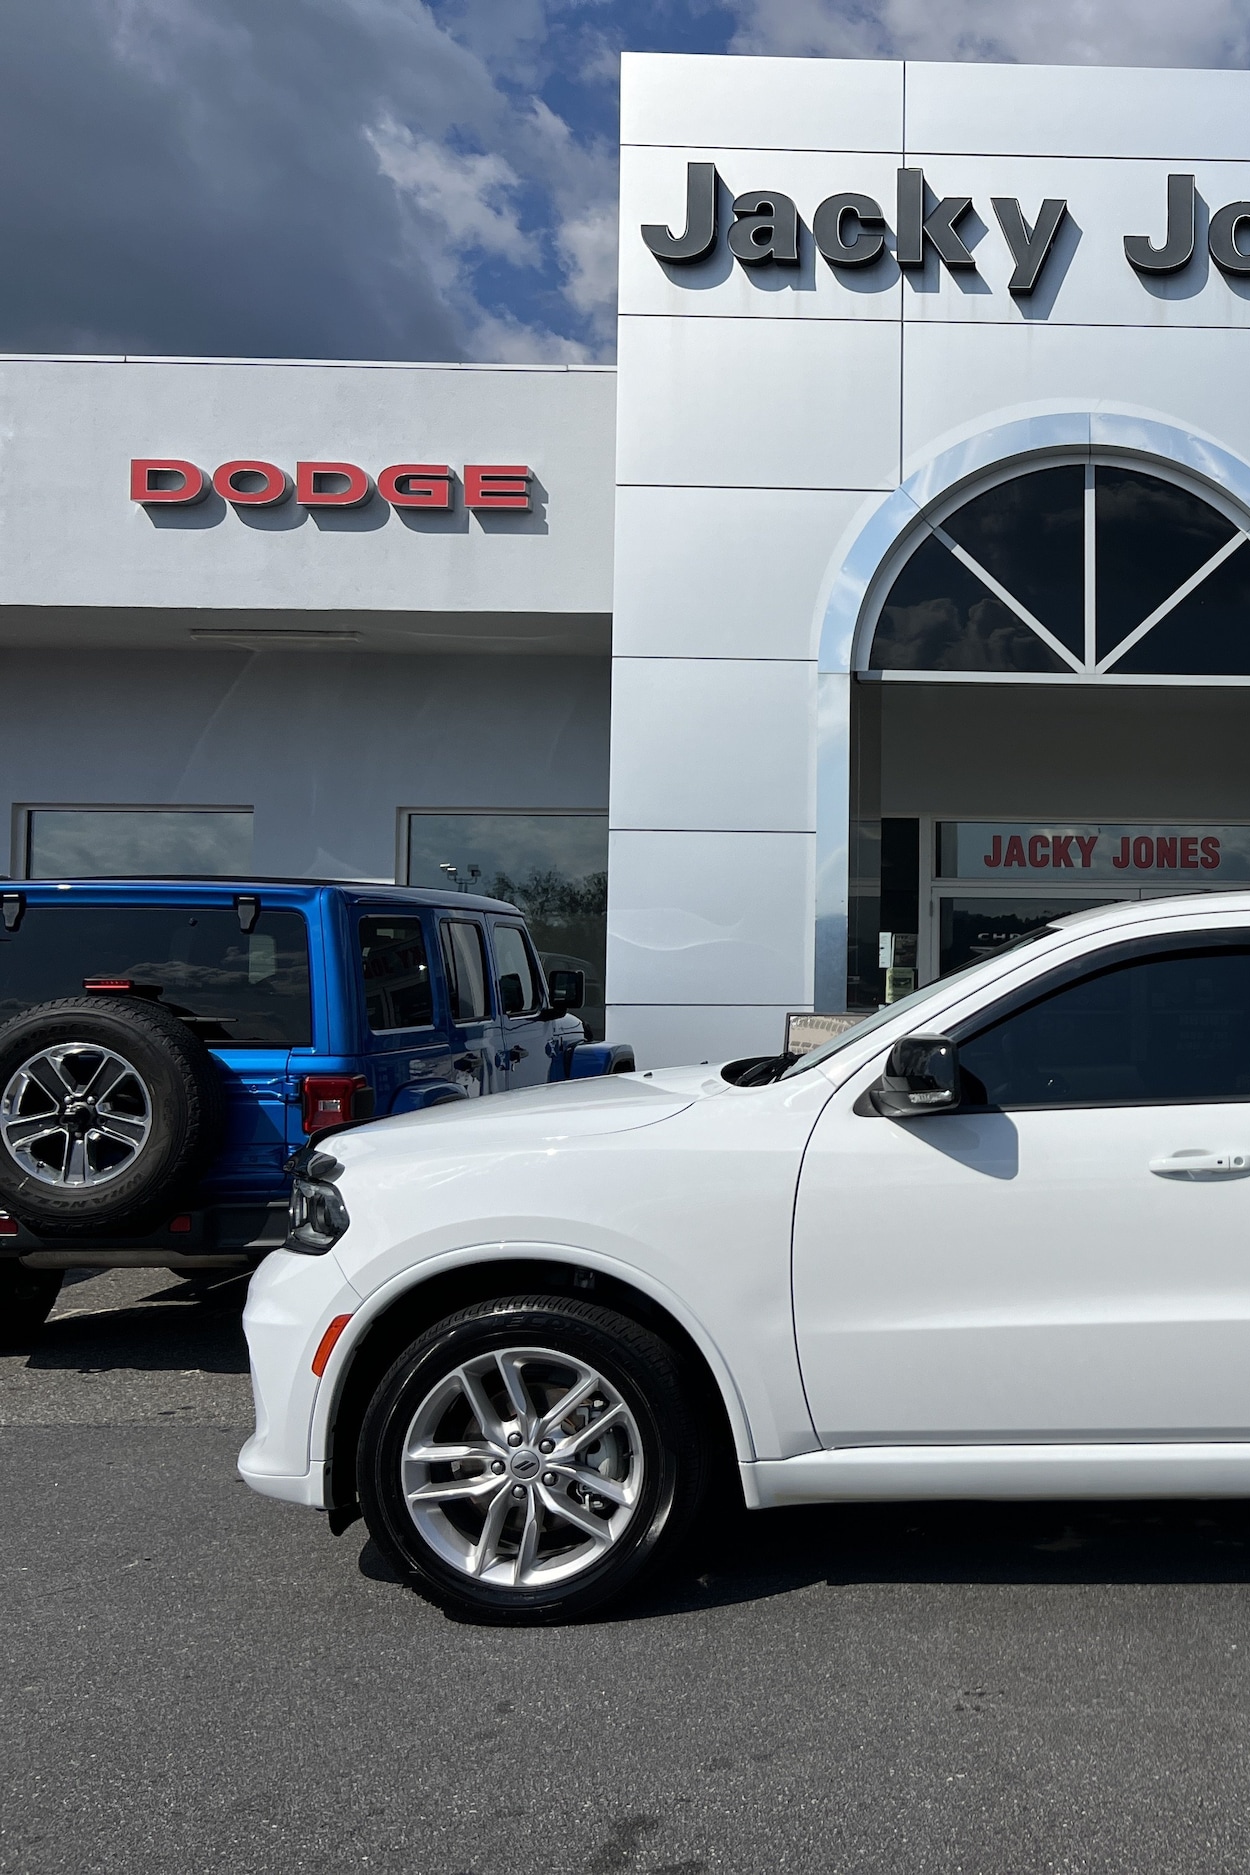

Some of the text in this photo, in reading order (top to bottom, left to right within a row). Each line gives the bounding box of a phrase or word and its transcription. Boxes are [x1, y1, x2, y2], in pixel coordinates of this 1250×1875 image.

[641, 162, 1067, 296] Jacky
[130, 459, 532, 512] DODGE
[983, 834, 1221, 869] JACKY JONES
